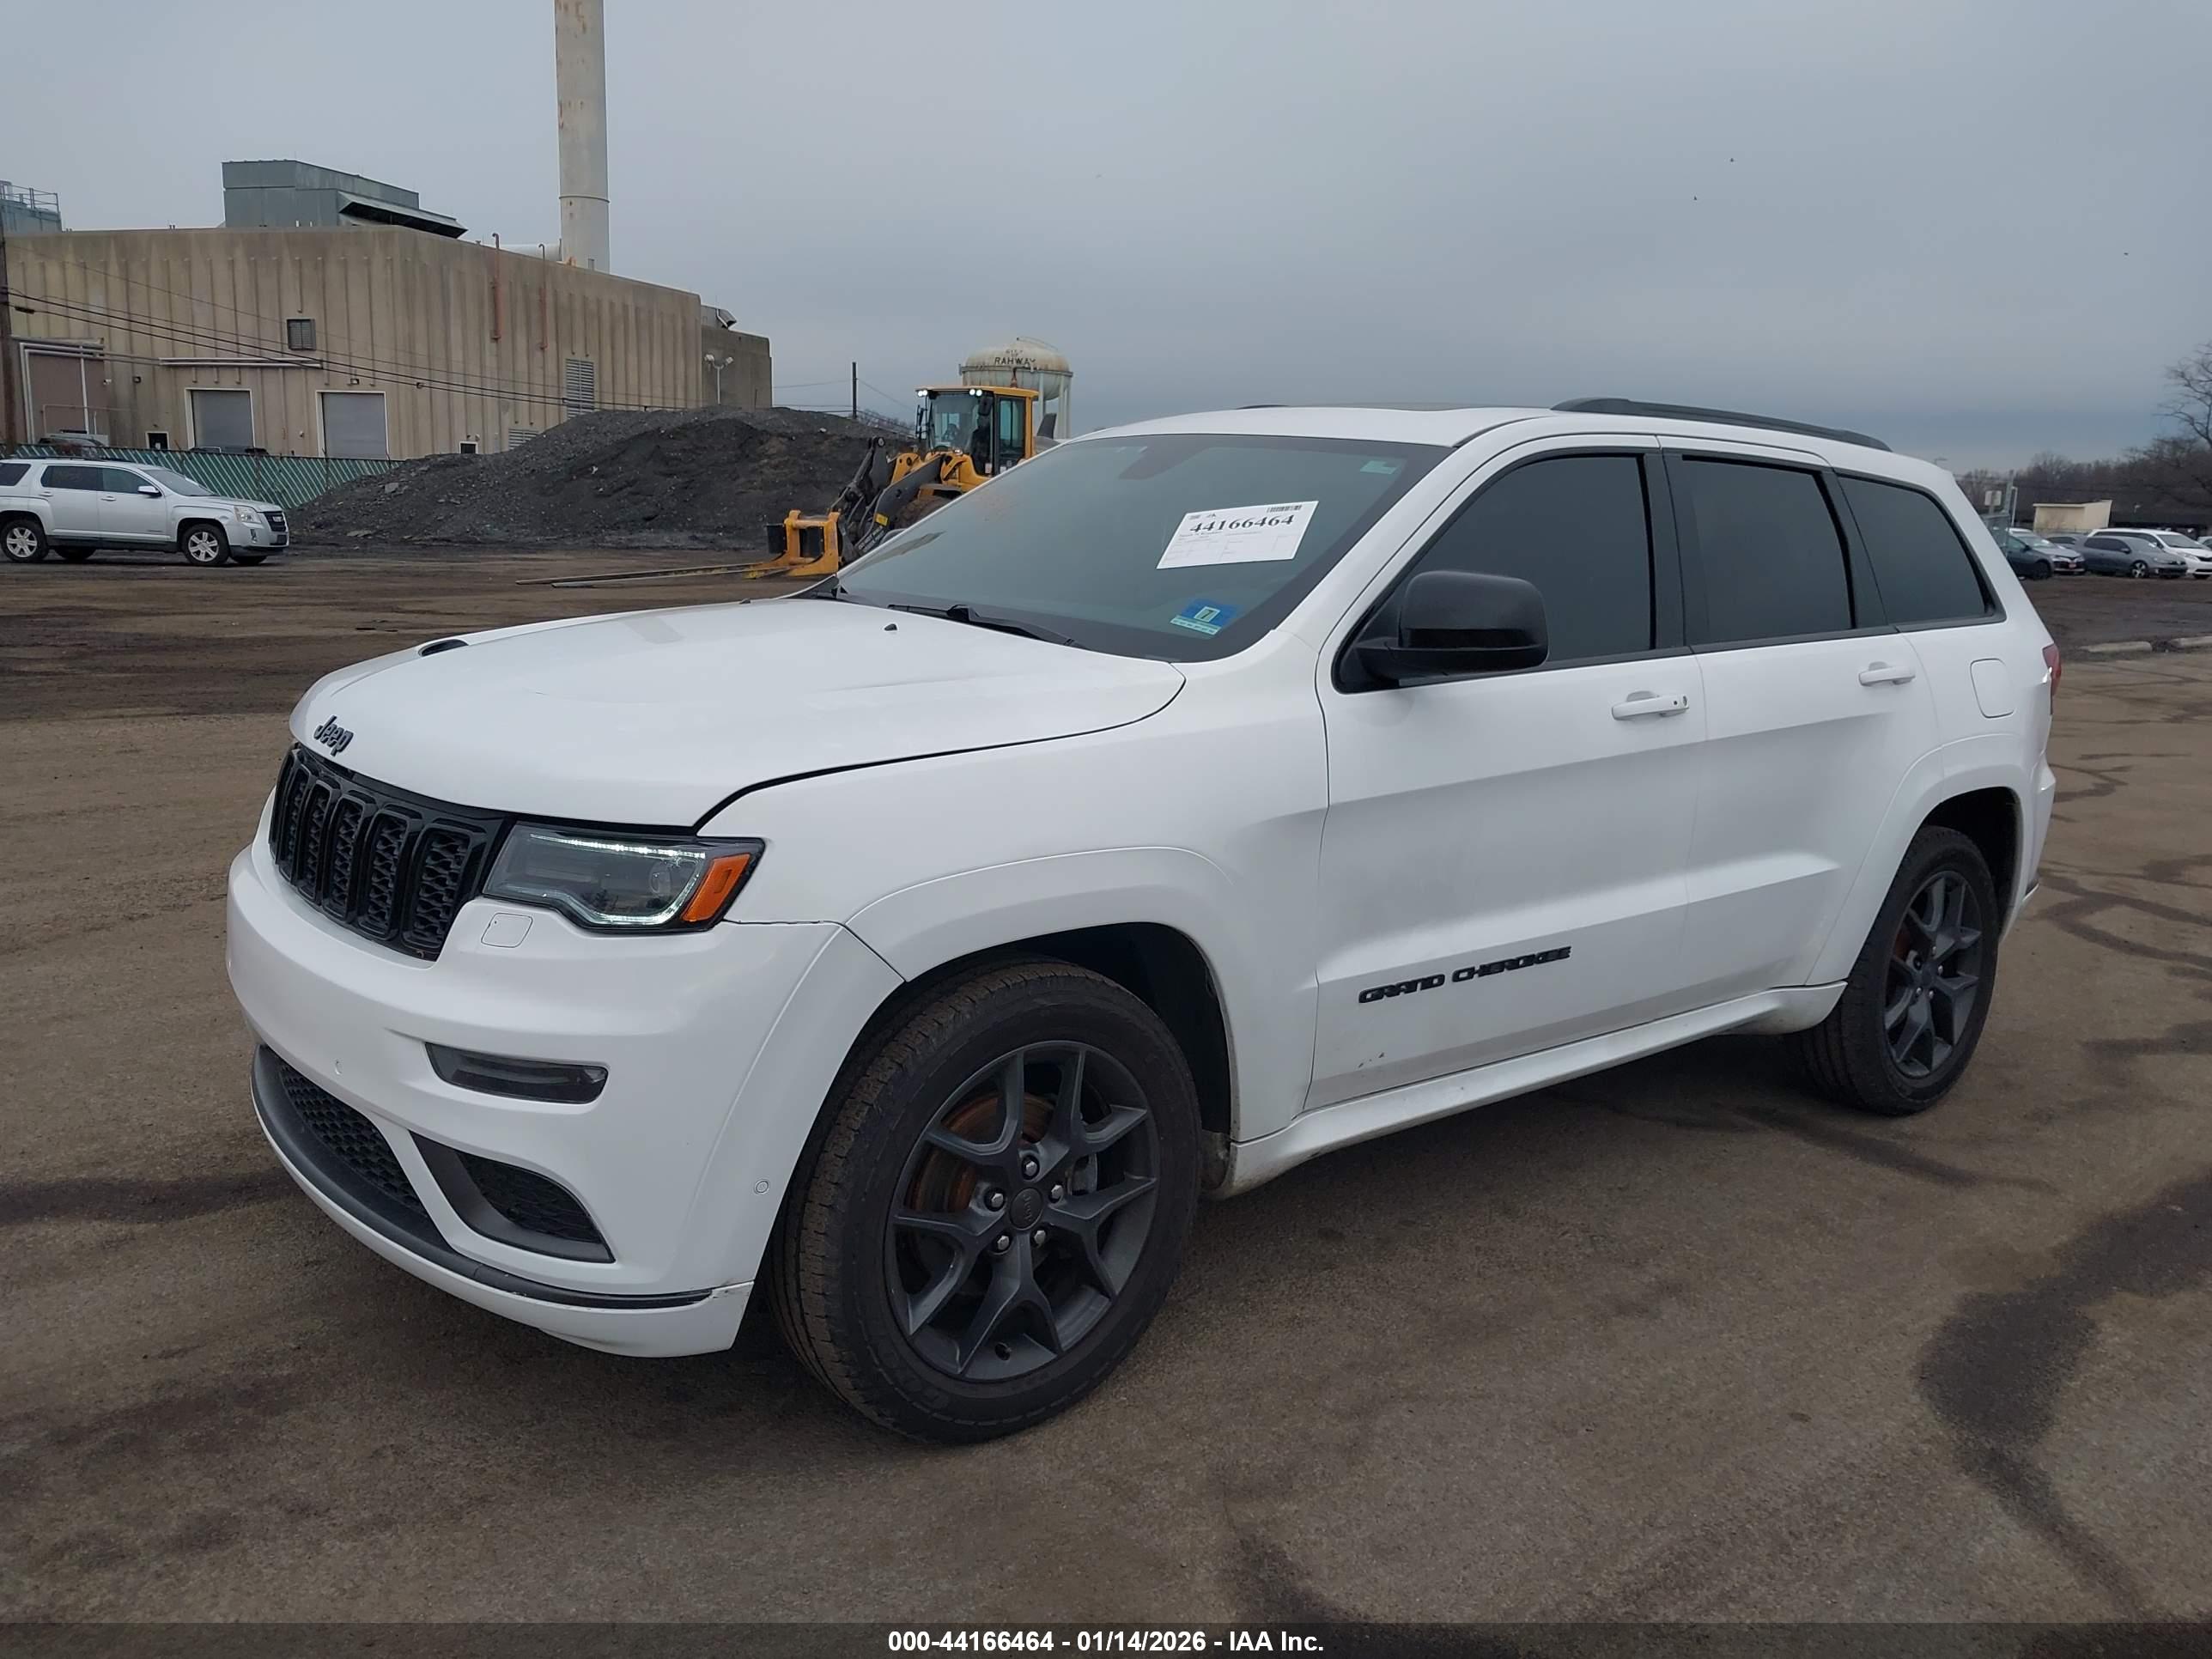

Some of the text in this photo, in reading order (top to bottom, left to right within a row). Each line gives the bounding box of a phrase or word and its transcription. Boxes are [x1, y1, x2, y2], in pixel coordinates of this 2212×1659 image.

[994, 356, 1036, 365] RAHWAY
[1190, 514, 1295, 532] 44166464
[313, 714, 354, 757] Jeep
[1358, 946, 1571, 1004] GRAND CHEROKEE
